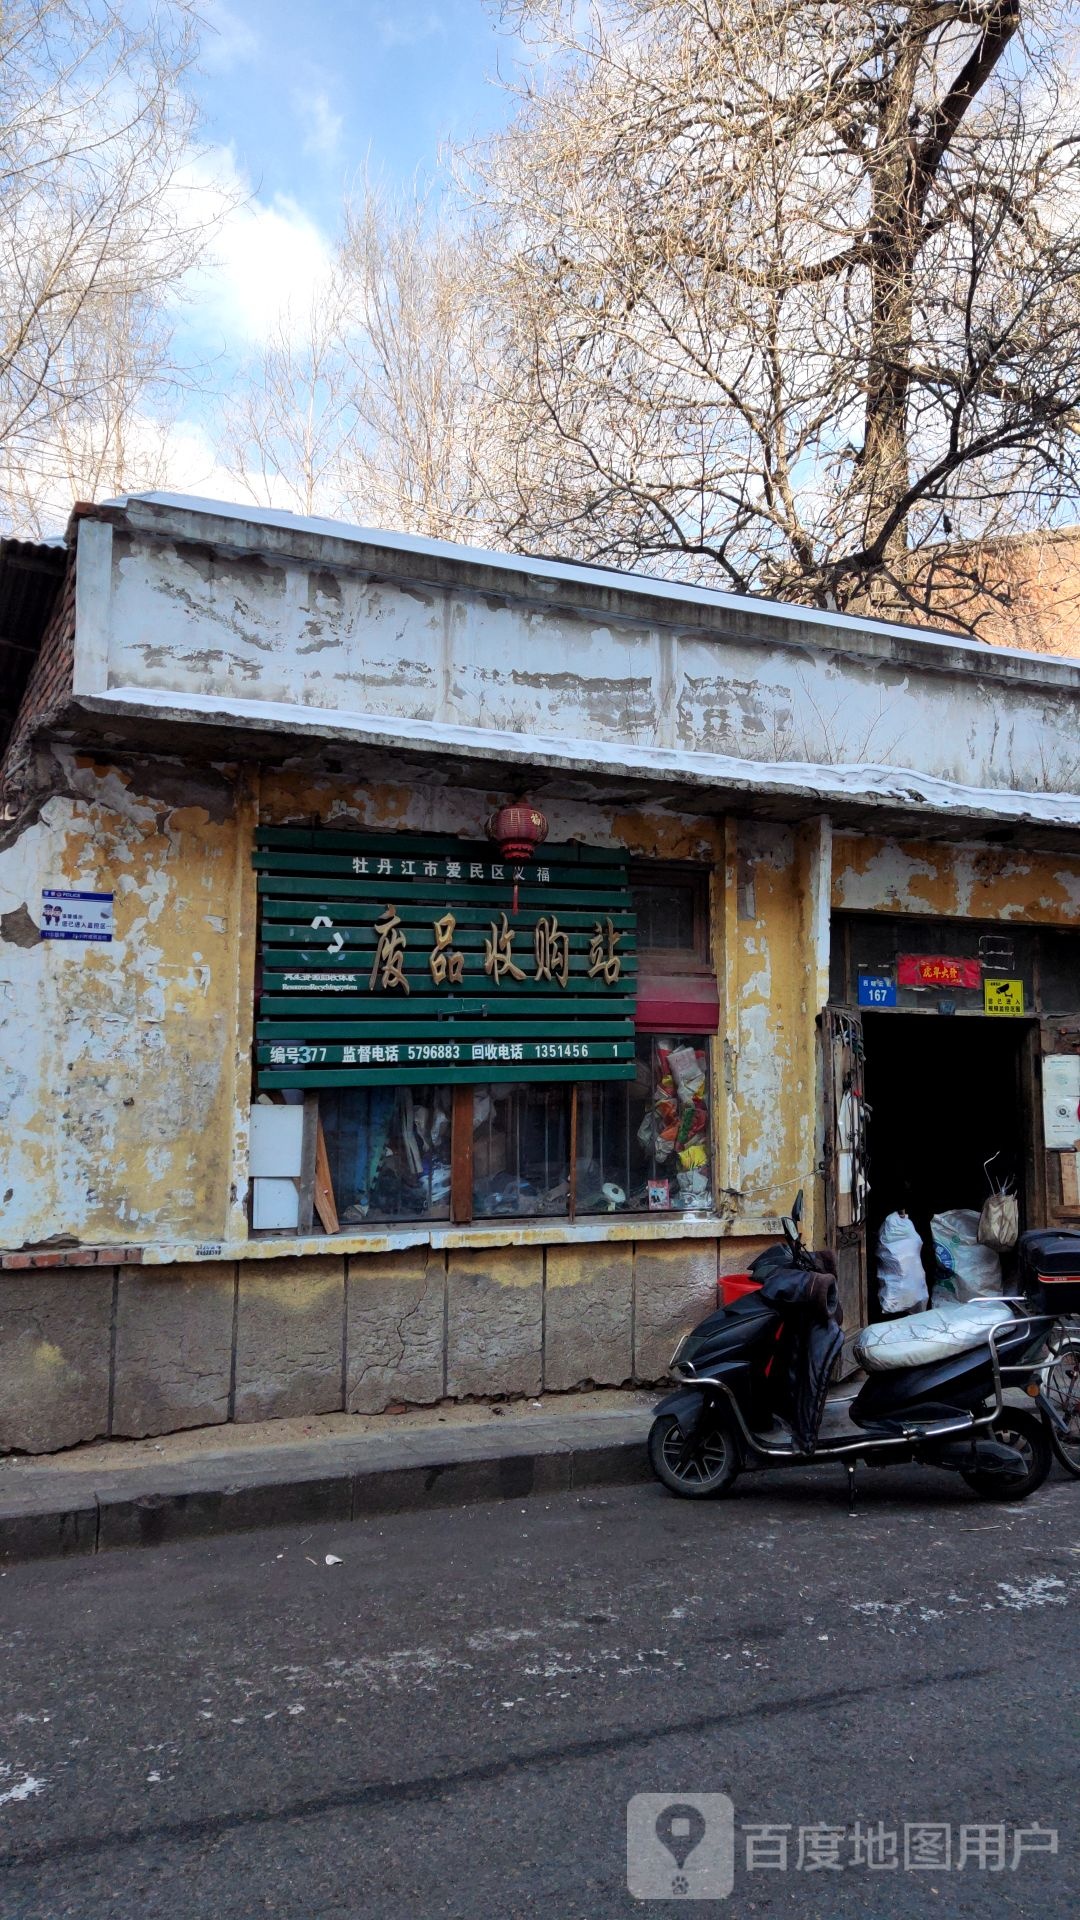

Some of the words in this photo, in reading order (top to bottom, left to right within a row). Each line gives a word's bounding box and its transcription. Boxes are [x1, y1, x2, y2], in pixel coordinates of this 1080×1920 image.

[369, 904, 621, 995] 废品收购站
[868, 989, 888, 1002] 167
[342, 1044, 400, 1063] 监督电话
[408, 1045, 461, 1060] 5796883
[471, 1043, 523, 1060] 回收电话
[535, 1044, 589, 1058] 1351456
